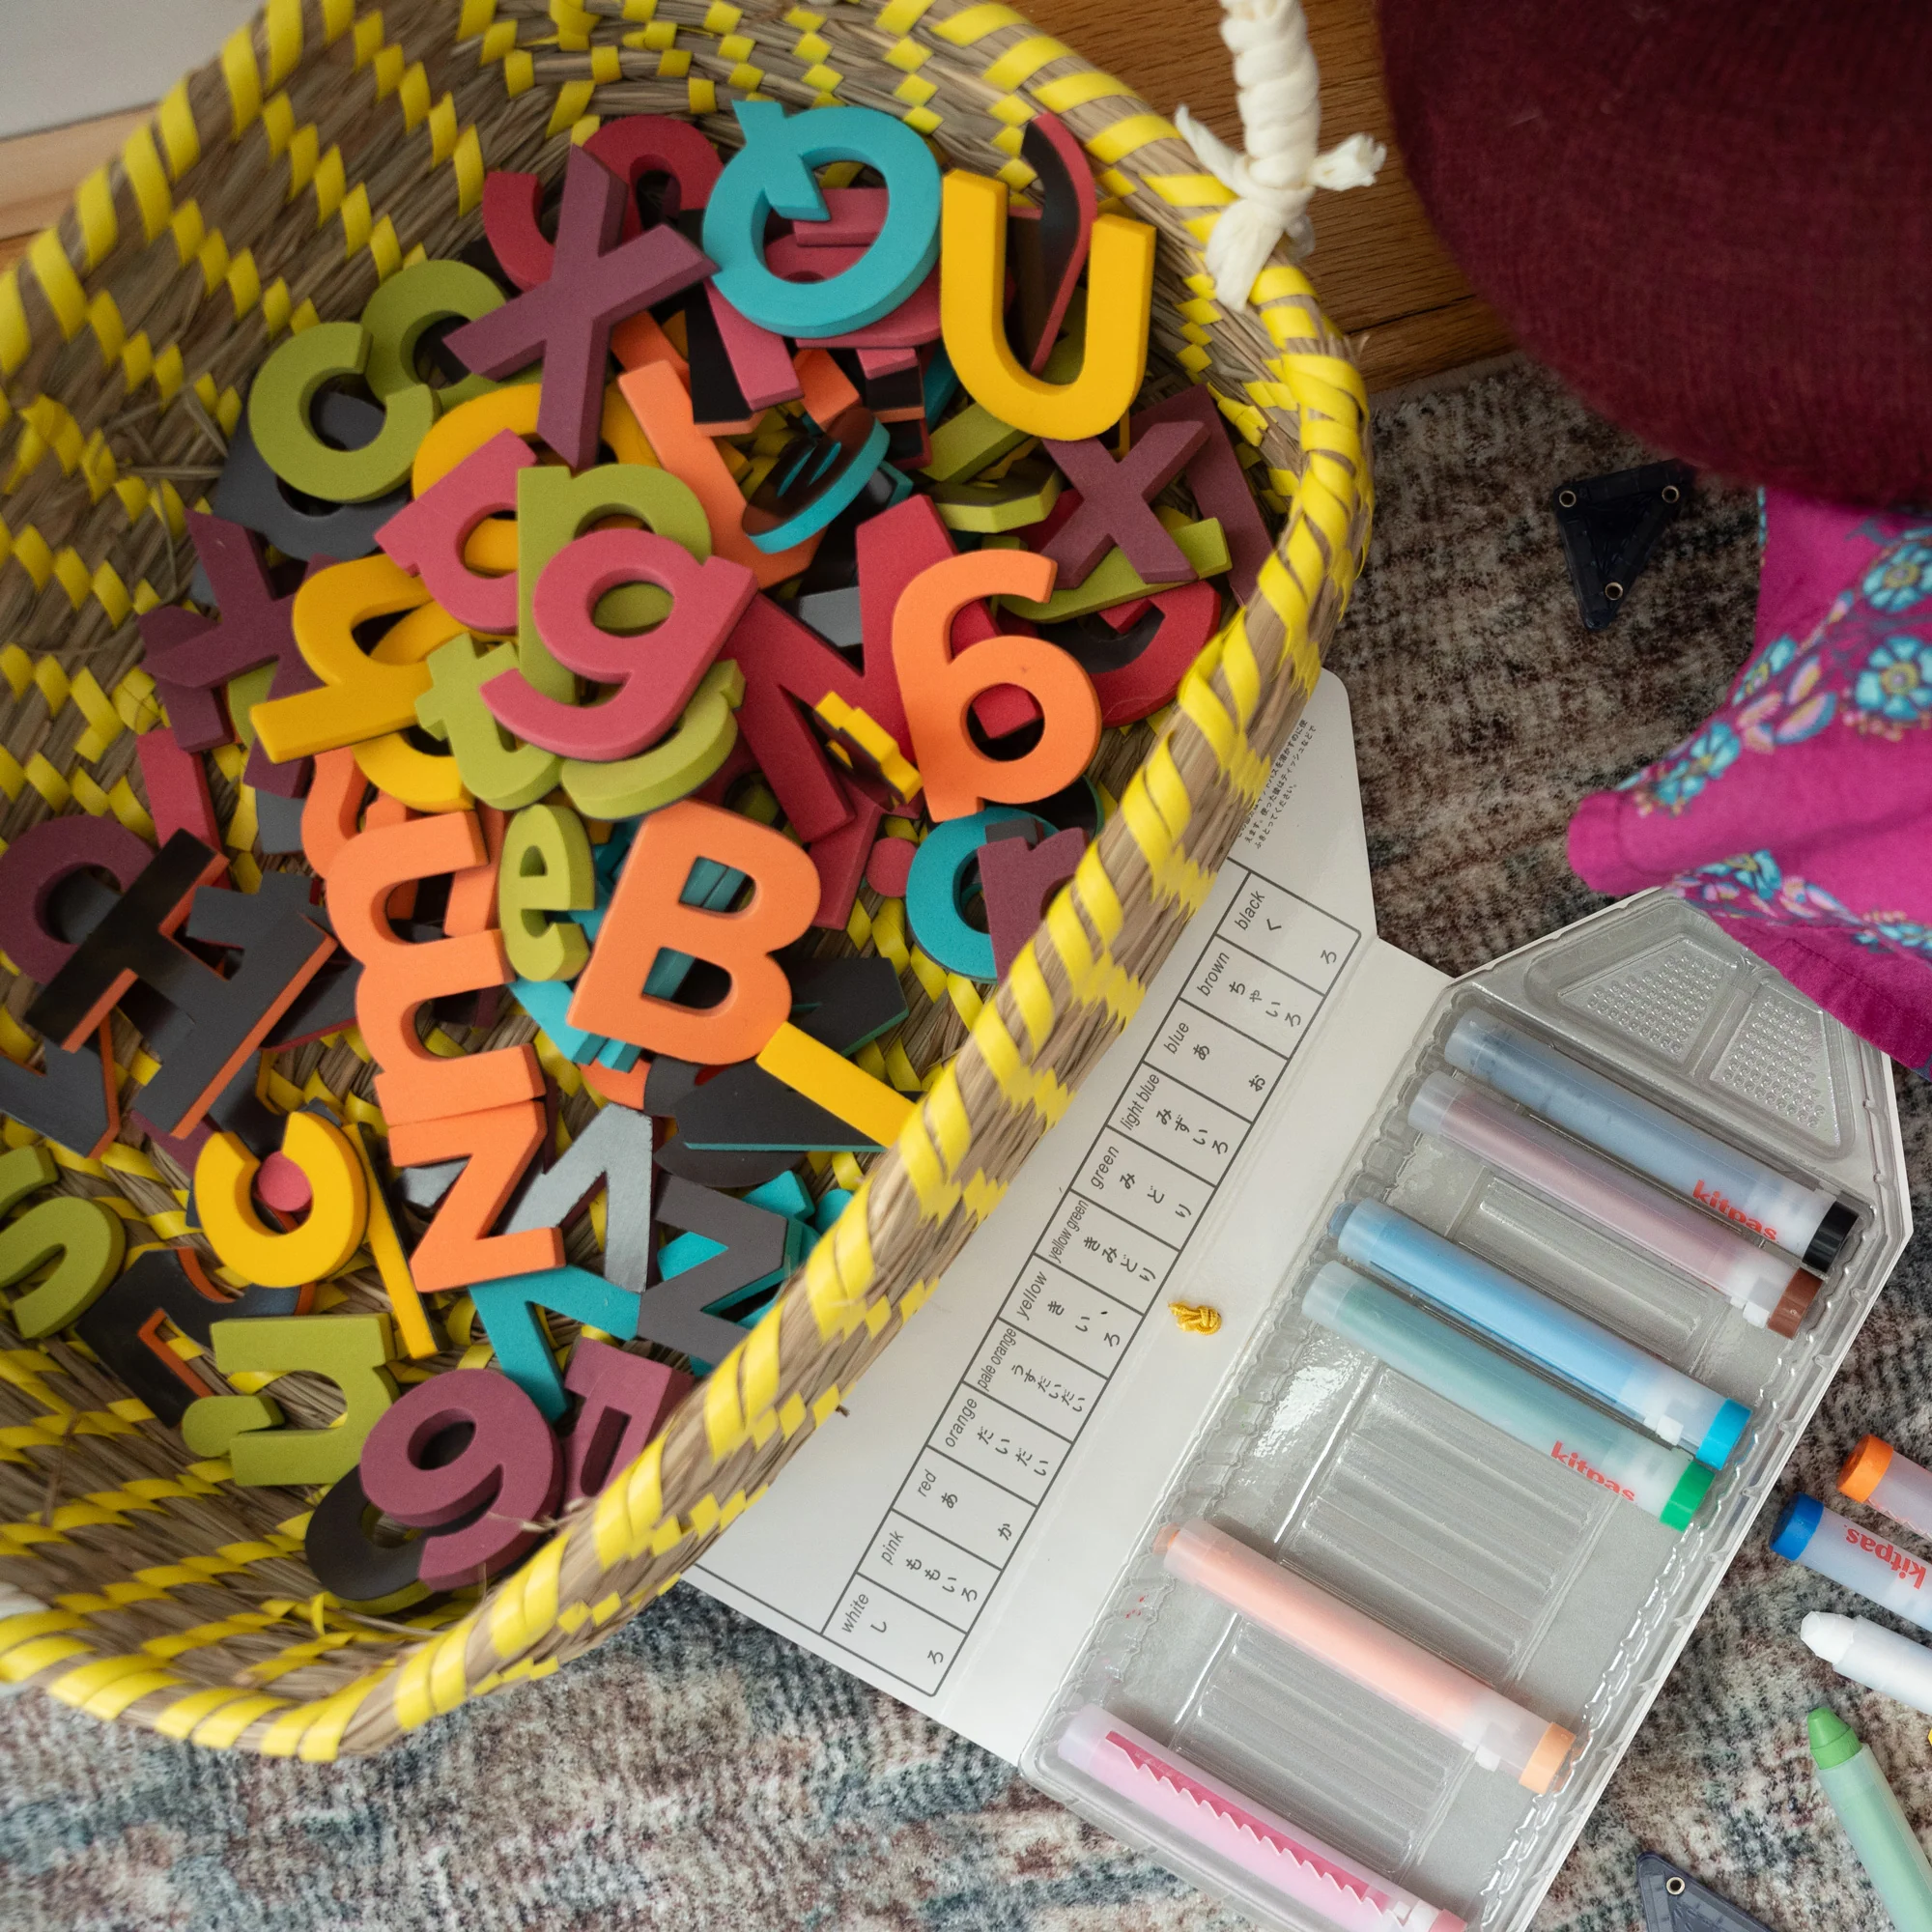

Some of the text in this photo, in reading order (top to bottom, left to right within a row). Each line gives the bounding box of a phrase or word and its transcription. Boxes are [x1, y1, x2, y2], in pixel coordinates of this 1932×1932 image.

[1233, 889, 1265, 931] black
[1195, 951, 1230, 997] brown
[1162, 1021, 1189, 1055] blue
[1119, 1072, 1160, 1131] light blue
[1089, 1145, 1120, 1190] green
[1047, 1198, 1089, 1264] yellow green
[1692, 1179, 1778, 1241] kitpas
[1015, 1269, 1047, 1321] yellow
[976, 1326, 1017, 1392] pale orange
[944, 1397, 978, 1448] orange
[916, 1467, 937, 1497] red
[879, 1529, 904, 1566] pink
[1846, 1527, 1927, 1589] kitpas
[840, 1592, 869, 1634] white
